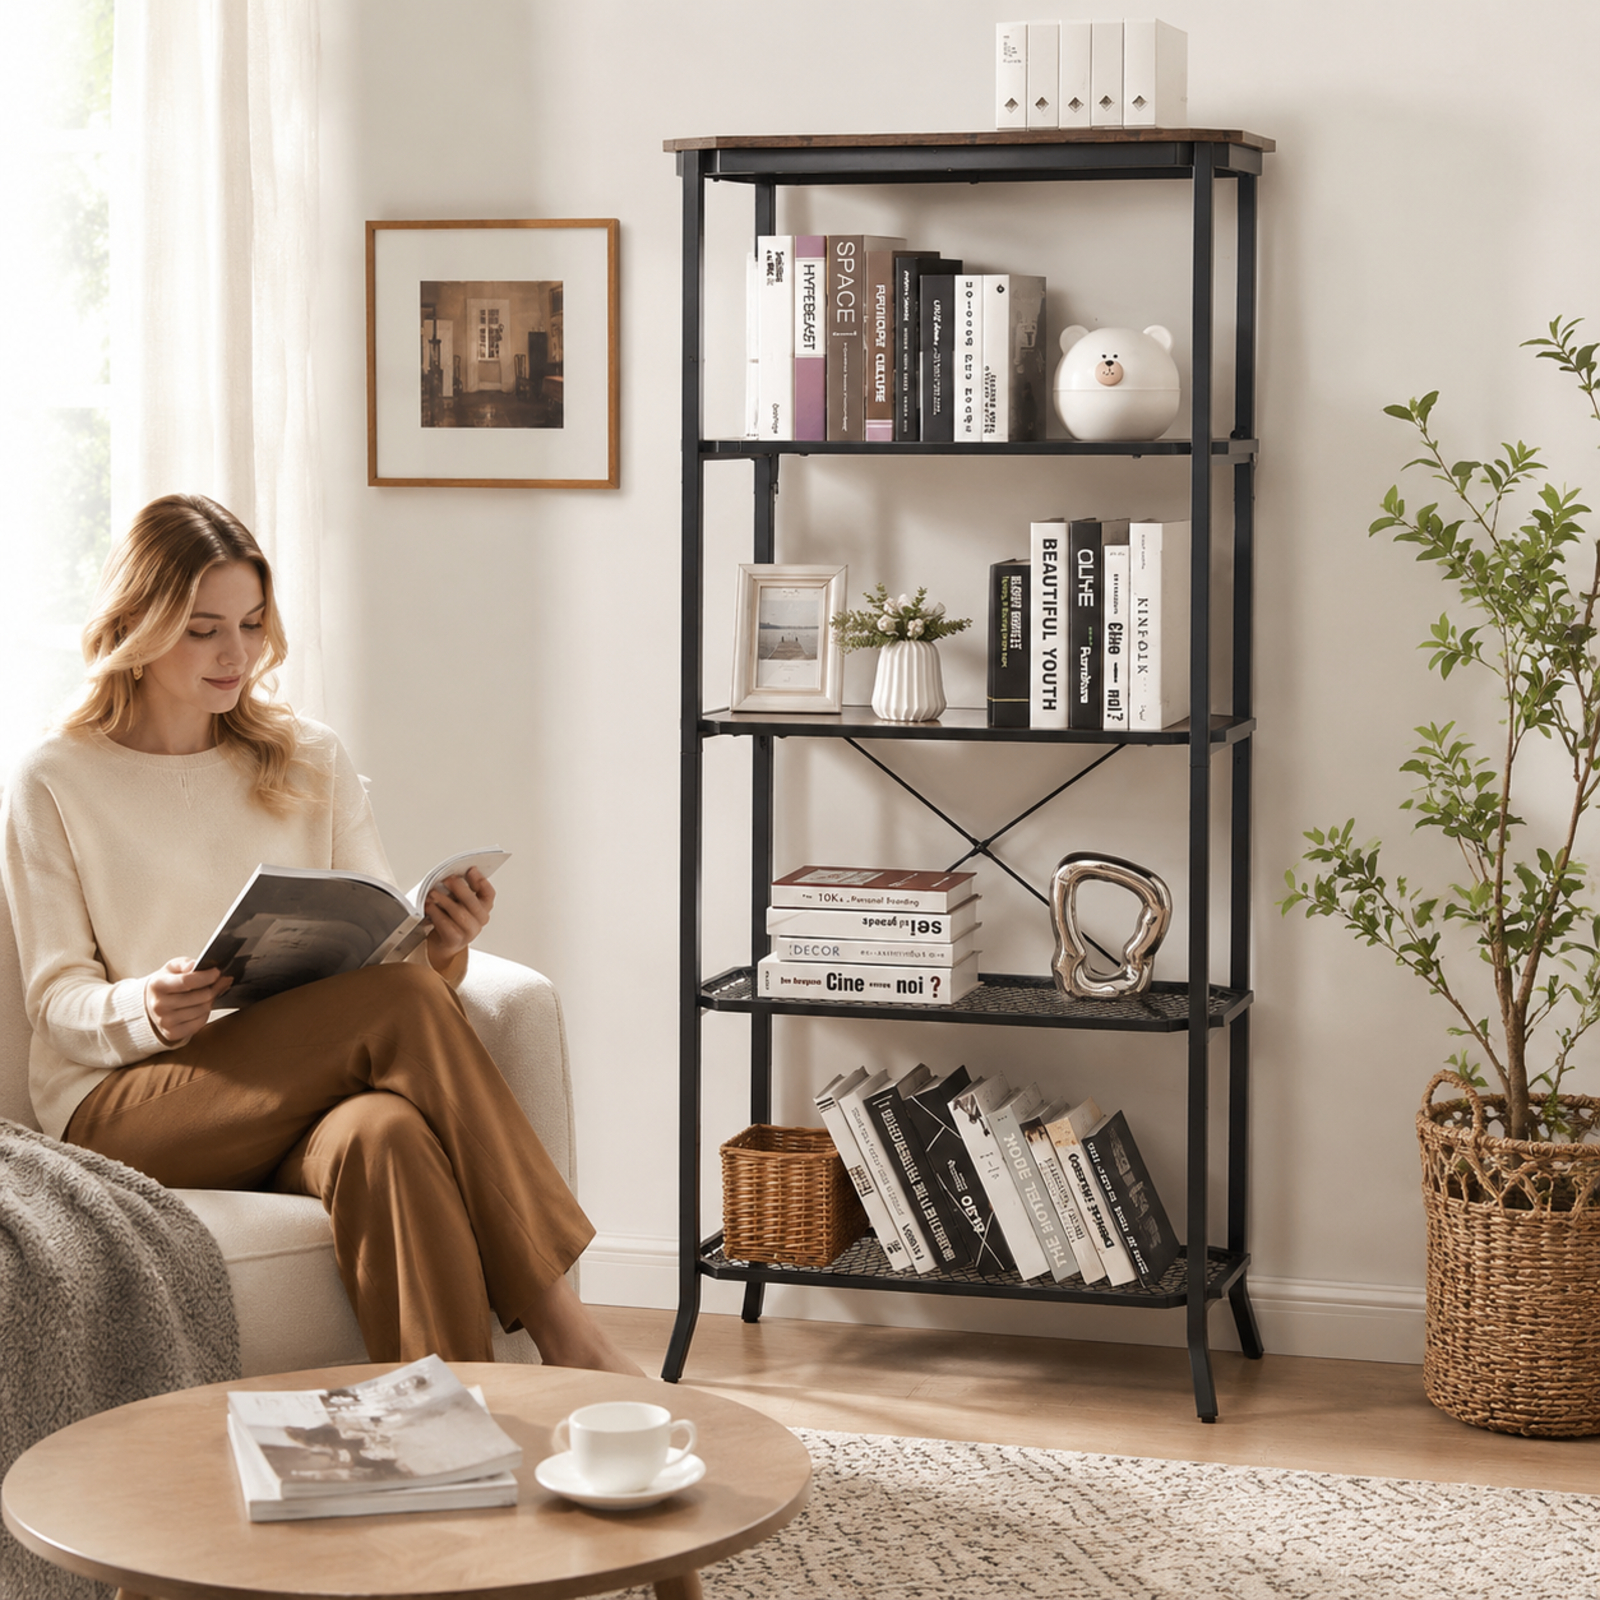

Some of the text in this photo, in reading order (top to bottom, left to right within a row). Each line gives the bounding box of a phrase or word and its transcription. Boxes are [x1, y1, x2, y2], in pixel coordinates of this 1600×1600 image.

[836, 241, 856, 323] SPACE
[1042, 538, 1058, 711] BEAUTIFUL YOUTH
[793, 944, 840, 957] DECOR
[826, 972, 865, 992] Cine
[896, 976, 924, 995] noi
[1045, 1233, 1068, 1269] THE
